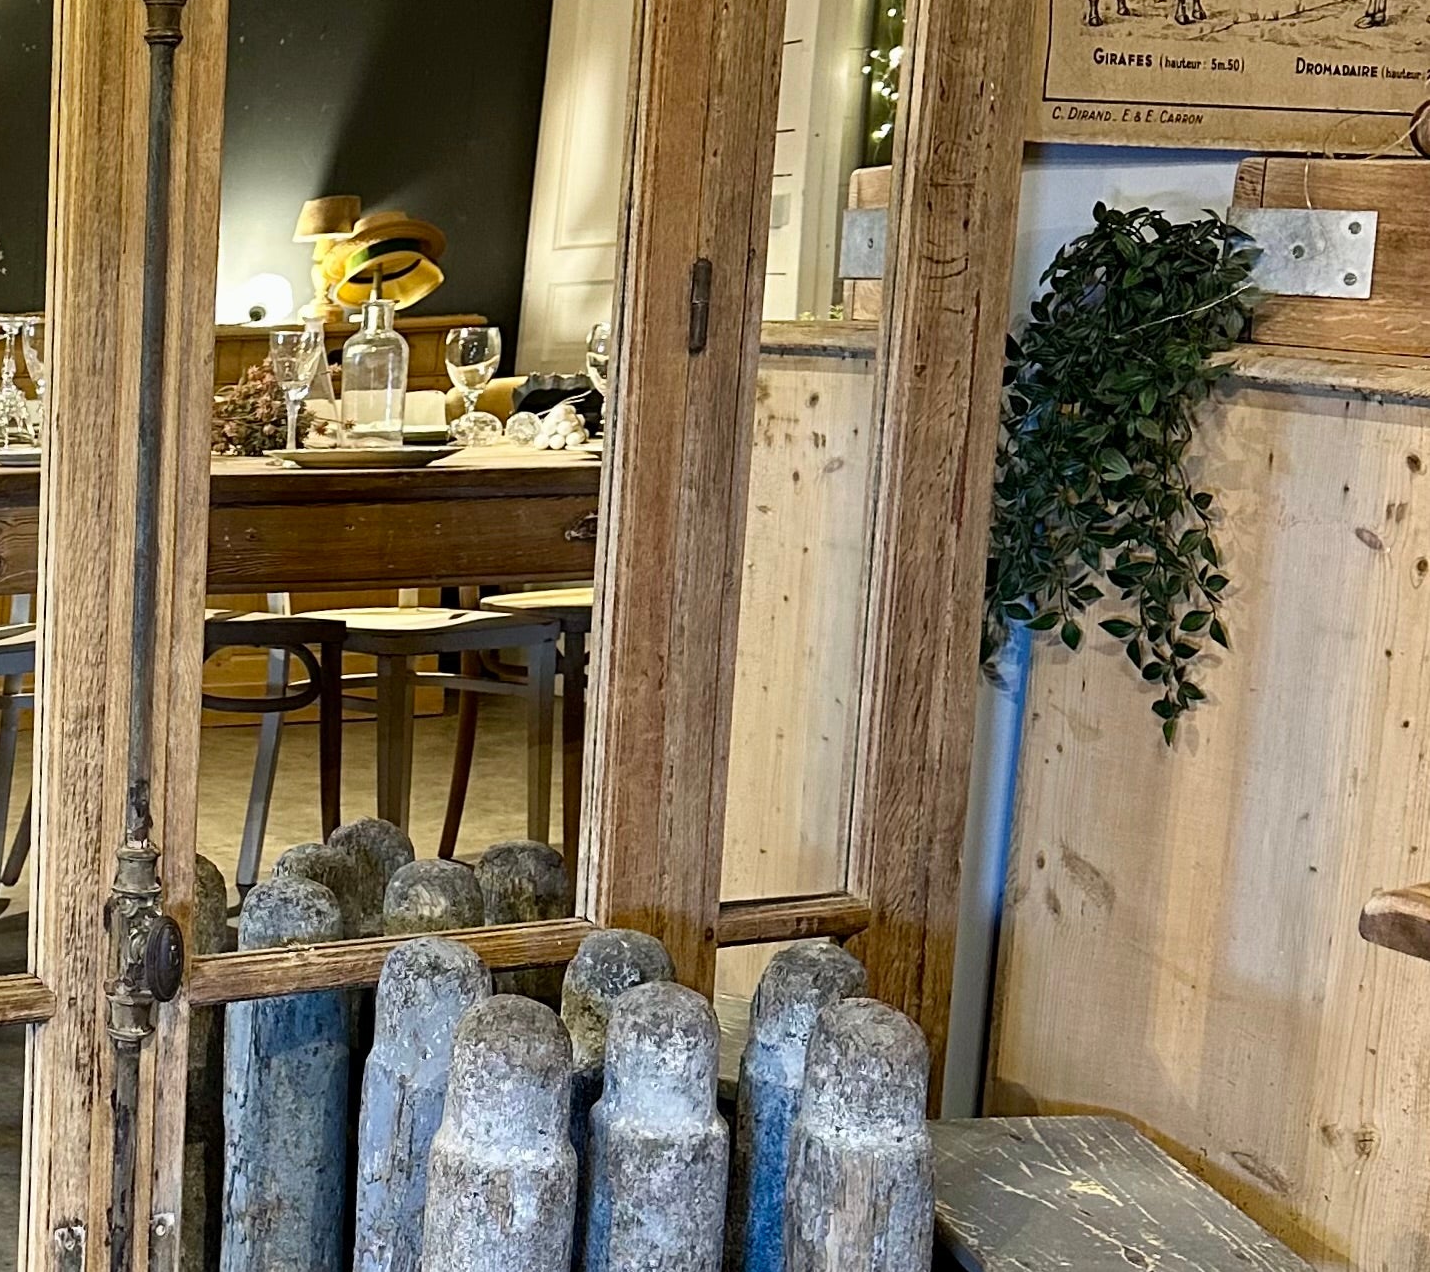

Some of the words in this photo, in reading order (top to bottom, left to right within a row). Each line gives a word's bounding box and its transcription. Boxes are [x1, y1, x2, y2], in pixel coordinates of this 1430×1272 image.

[1093, 47, 1153, 68] GIRAFES
[1295, 56, 1378, 78] DROMADAIRE
[1160, 110, 1204, 125] CARRON
